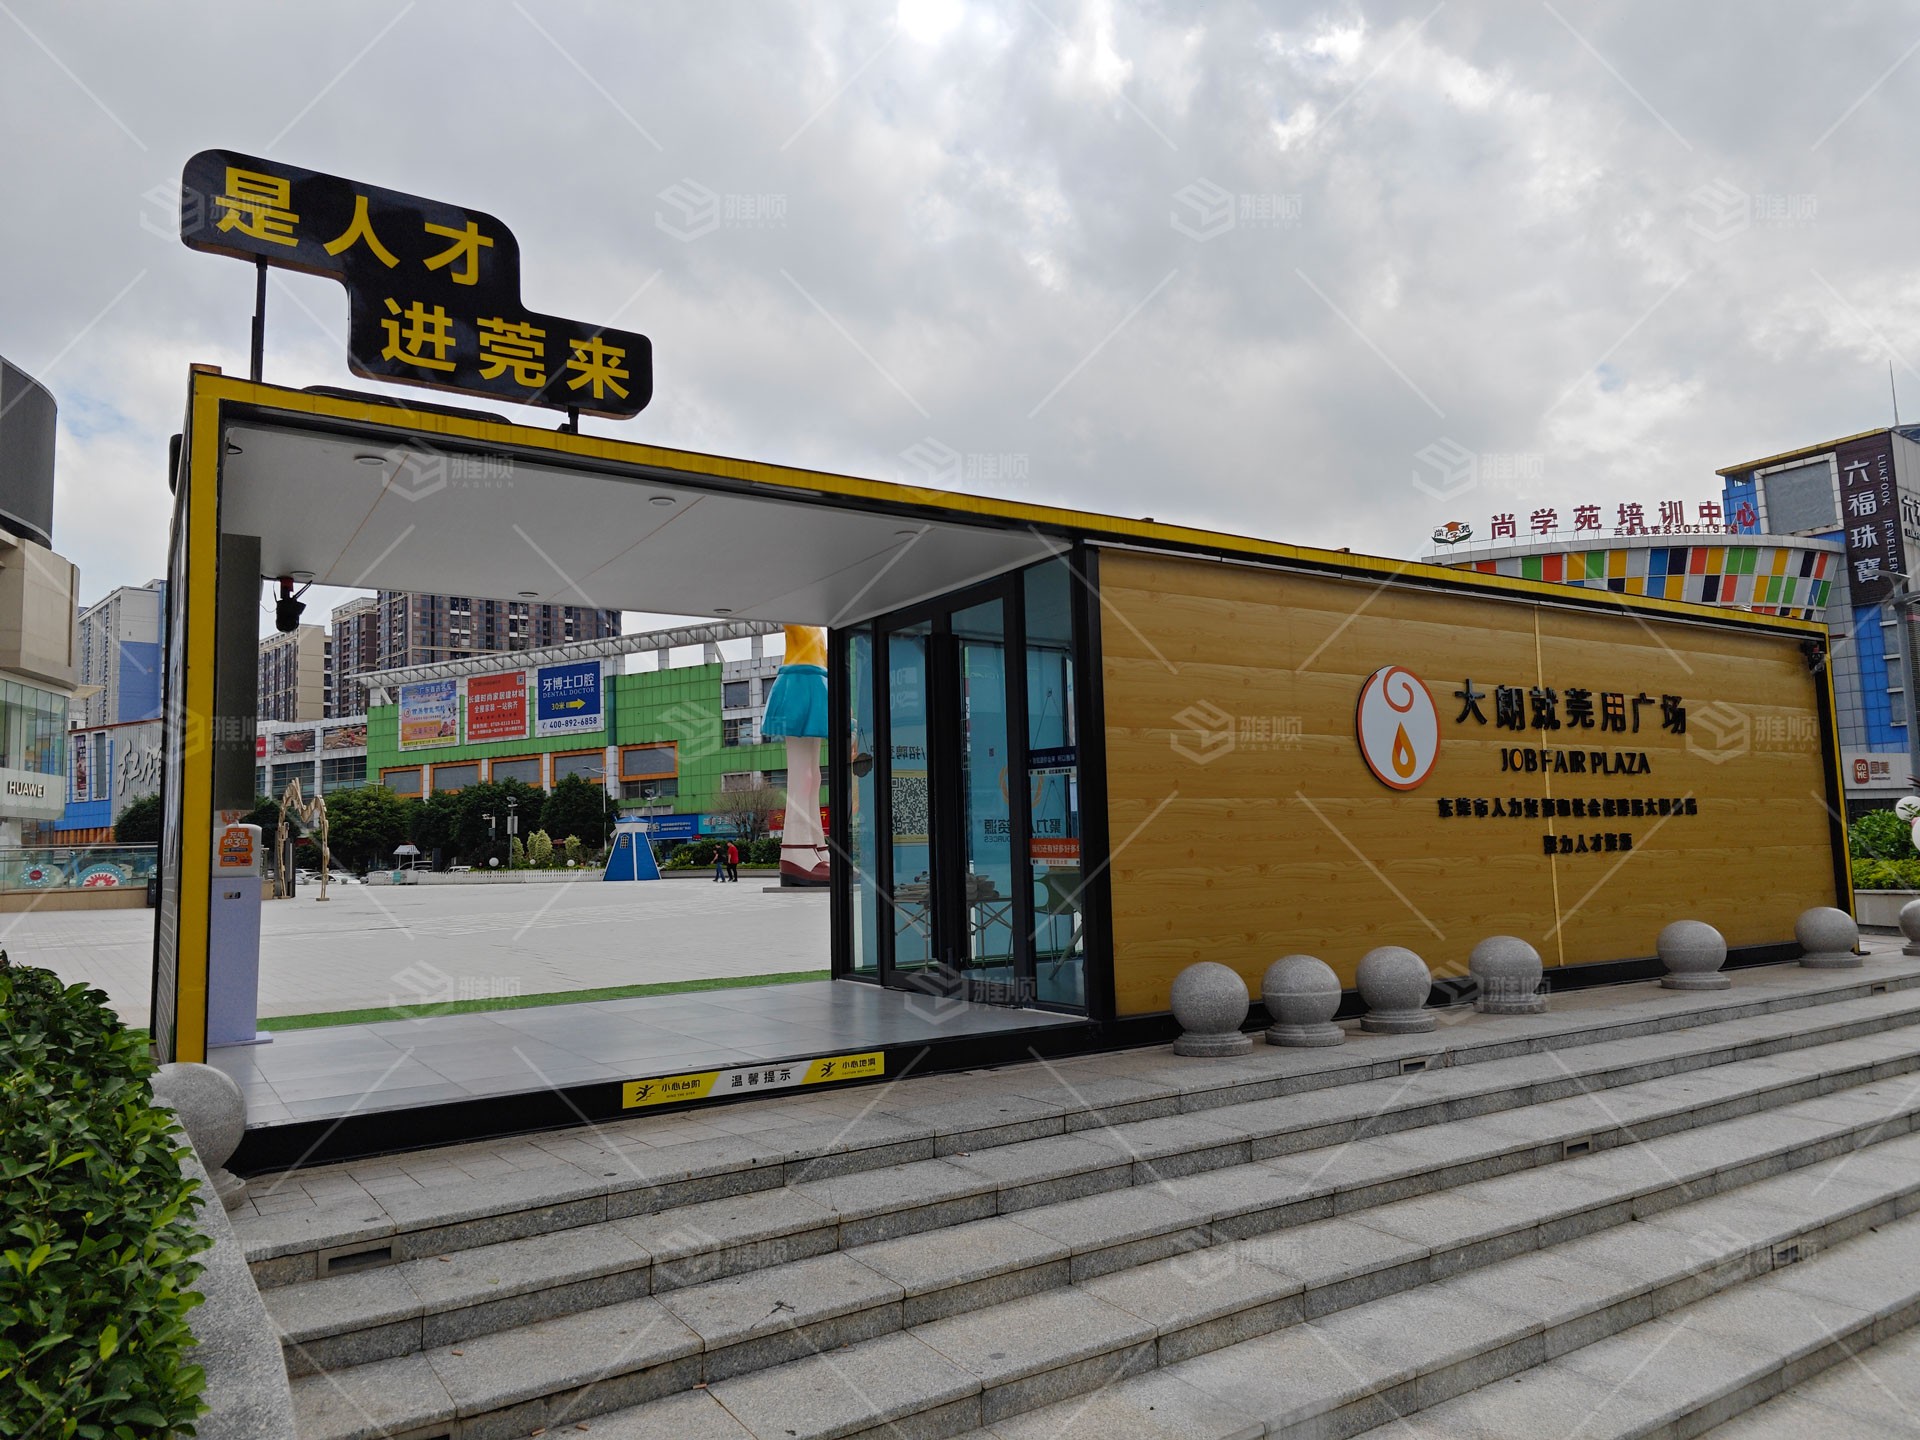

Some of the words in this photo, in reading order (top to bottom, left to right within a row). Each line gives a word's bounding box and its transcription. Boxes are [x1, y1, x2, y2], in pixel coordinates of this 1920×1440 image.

[215, 166, 495, 286] 是人才
[380, 297, 630, 400] 进莞来
[1877, 453, 1891, 506] LUKFOOK
[1490, 499, 1758, 539] 尚学苑培训中心
[1844, 460, 1882, 584] 六福珠寶
[542, 672, 595, 692] 牙博士口腔
[542, 690, 567, 698] DENTAL
[569, 687, 595, 695] DOCTOR
[1455, 678, 1687, 734] 大朗就莞用广场
[549, 717, 598, 728] 400-892-6858
[1501, 748, 1538, 772] JOB
[1541, 750, 1586, 773] FAIR
[1591, 752, 1651, 775] PLAZA
[1857, 771, 1868, 779] ME
[7, 781, 46, 798] HUAWEI
[841, 1057, 876, 1069] 小心地滑
[661, 1079, 701, 1092] 小心台阶
[731, 1069, 791, 1088] 温馨提示
